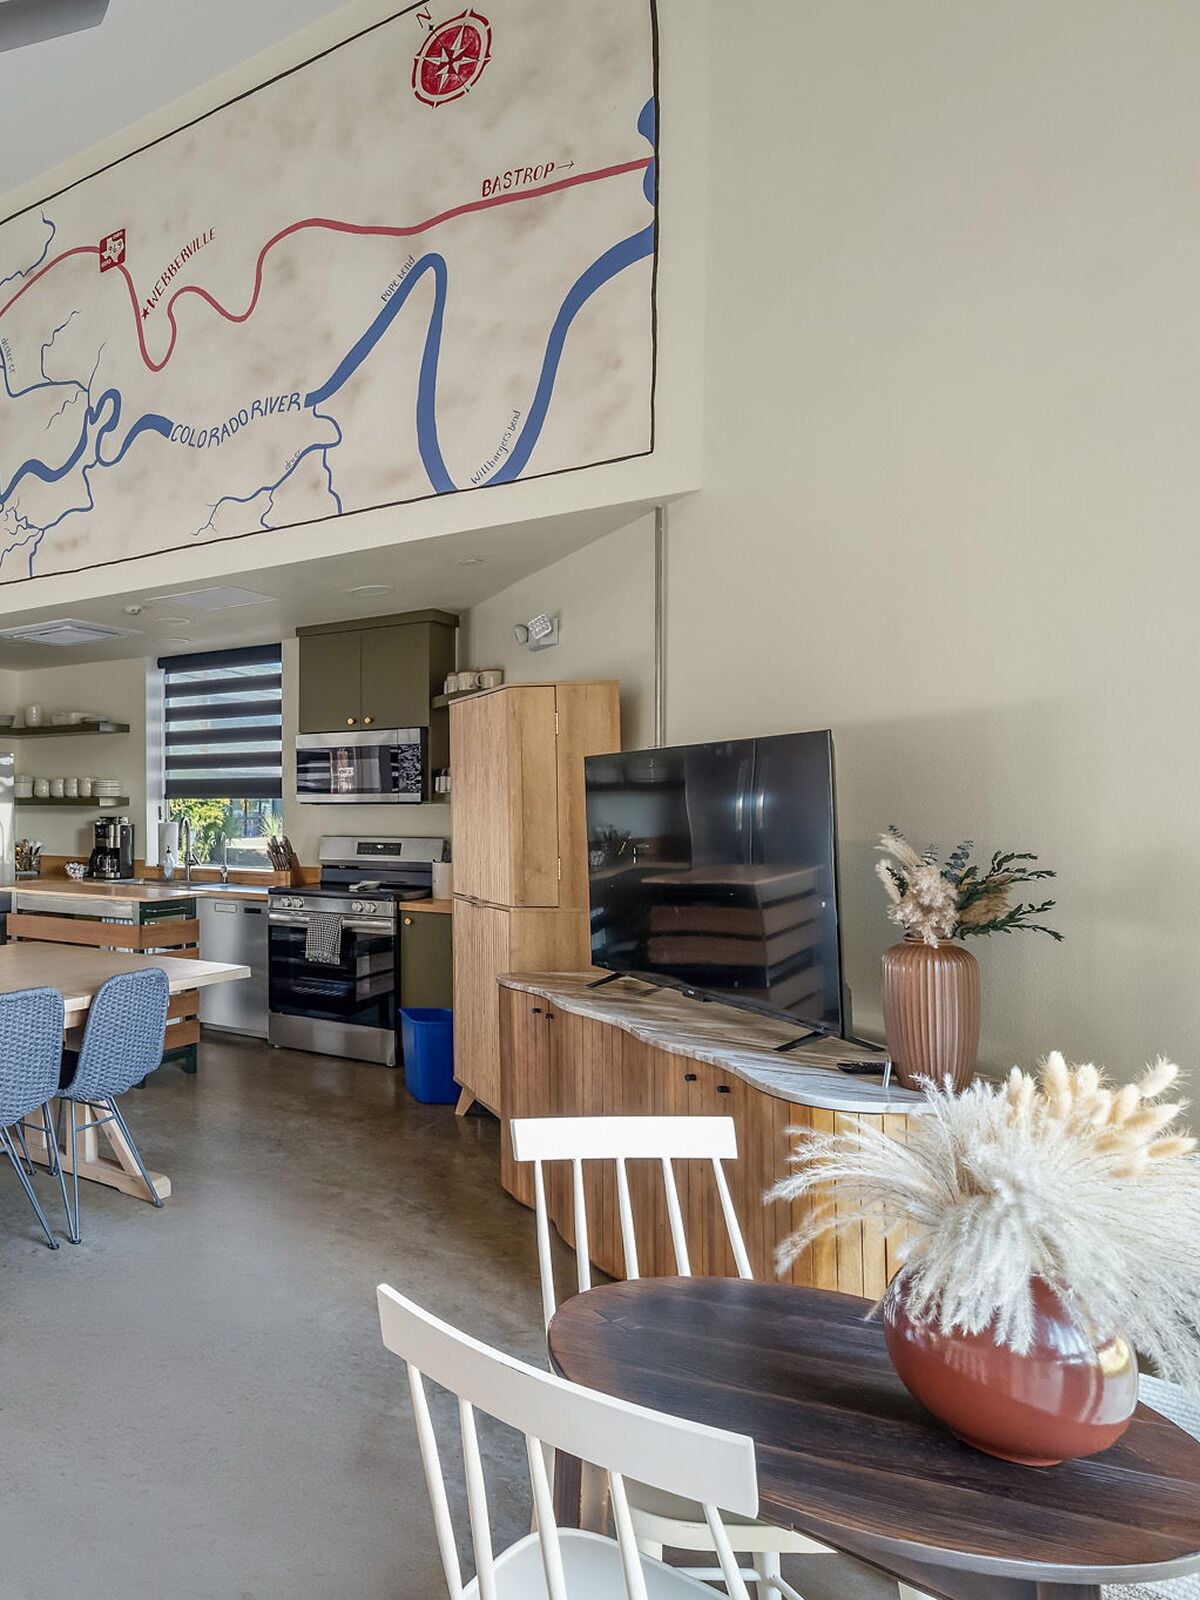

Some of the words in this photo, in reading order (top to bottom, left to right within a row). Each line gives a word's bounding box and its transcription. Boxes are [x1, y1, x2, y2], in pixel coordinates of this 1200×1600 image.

[415, 6, 432, 29] N
[482, 161, 555, 198] BASTROP
[108, 240, 122, 254] 969
[146, 226, 216, 309] WEBBERVILLE
[170, 409, 249, 449] COLORADO
[250, 392, 301, 420] RIVER
